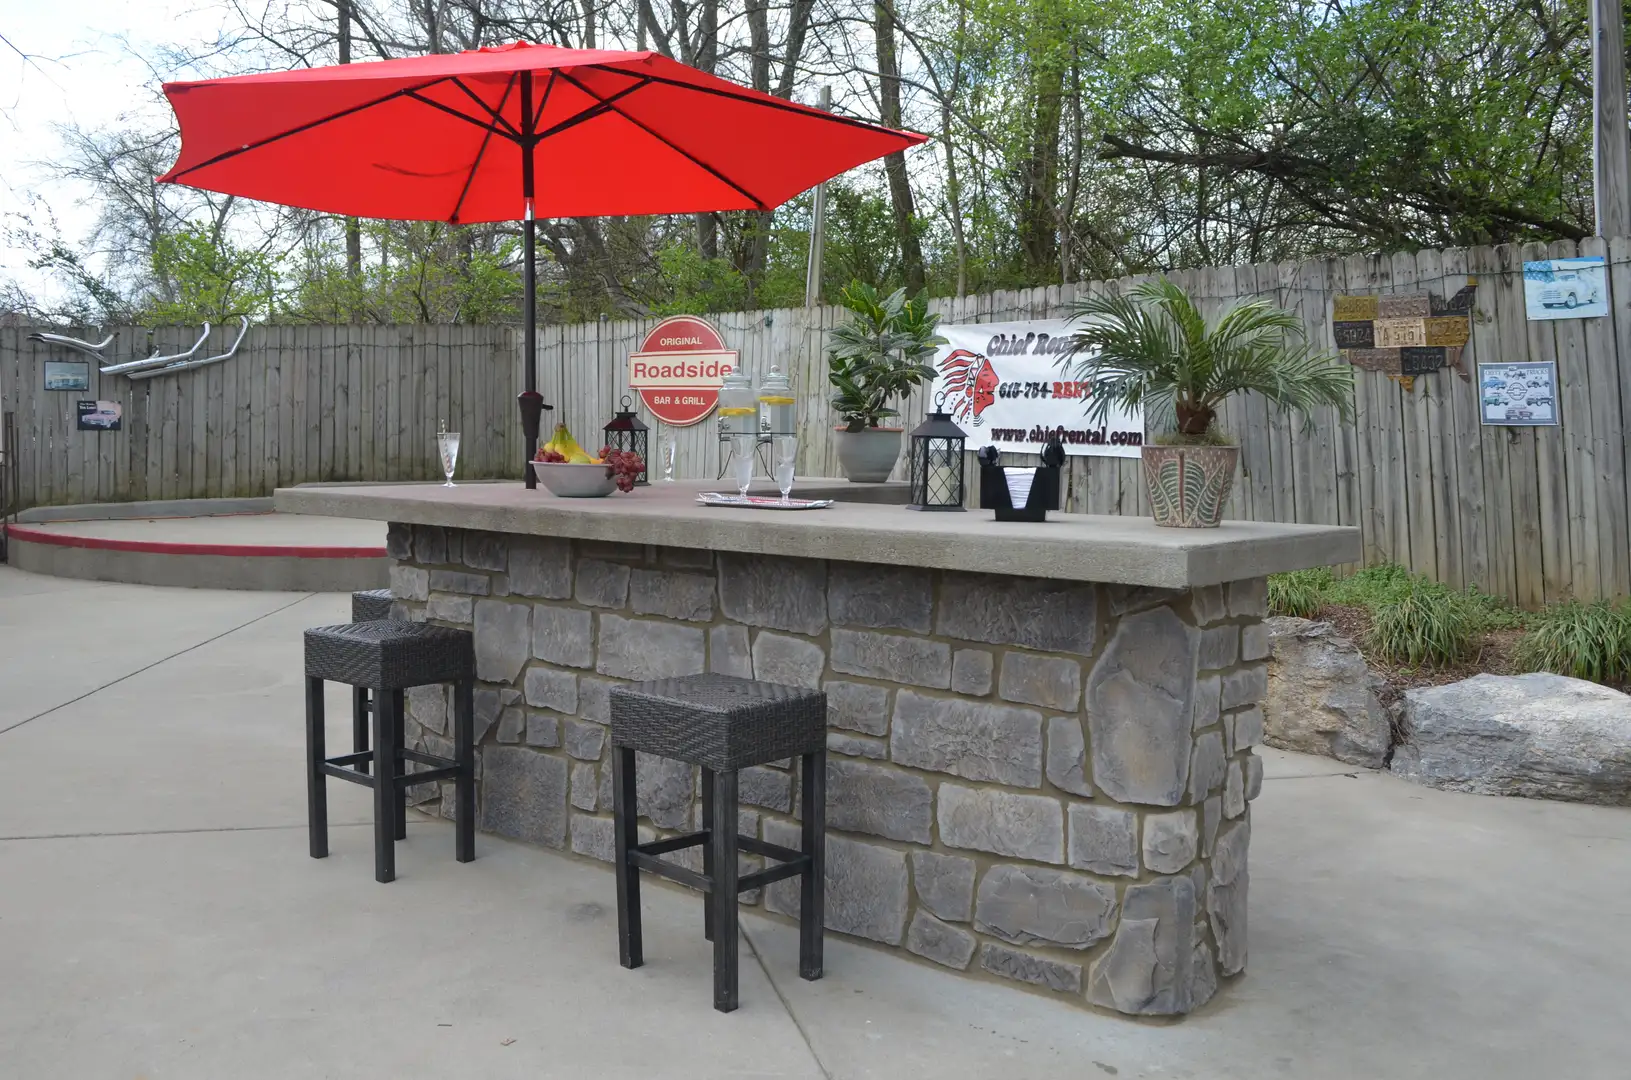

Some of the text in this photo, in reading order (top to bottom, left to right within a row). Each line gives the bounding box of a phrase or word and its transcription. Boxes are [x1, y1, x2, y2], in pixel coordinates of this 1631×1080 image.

[660, 336, 702, 346] ORIGINAL
[986, 332, 1035, 357] Chief
[634, 360, 733, 379] Roadside
[654, 396, 706, 406] BAR & GRILL
[991, 425, 1143, 447] www.chiefrental.com
